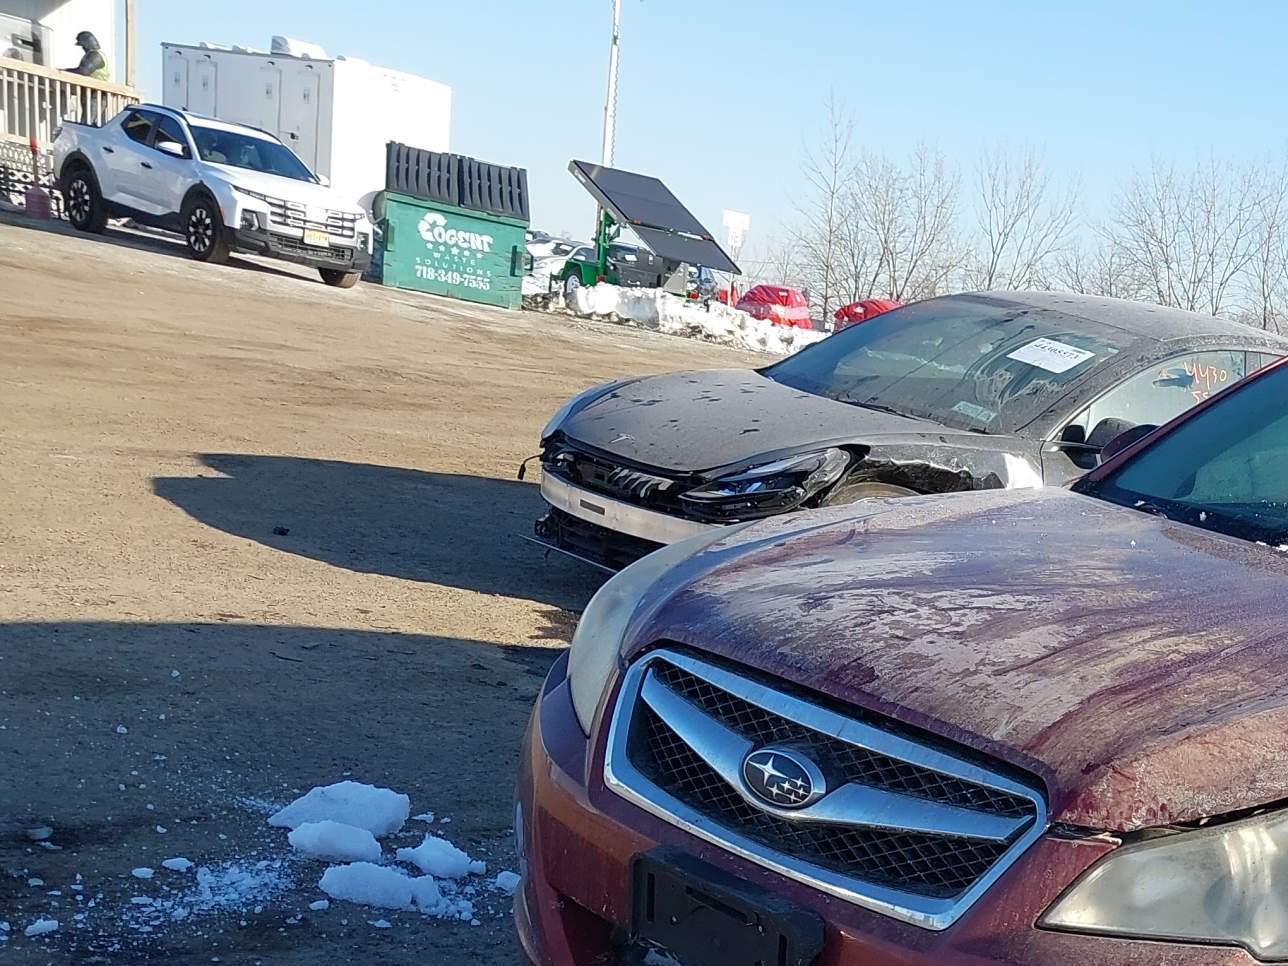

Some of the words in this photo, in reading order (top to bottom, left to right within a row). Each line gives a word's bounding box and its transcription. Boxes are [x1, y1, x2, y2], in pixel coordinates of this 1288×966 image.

[415, 256, 492, 277] SOLUTIONS
[433, 252, 476, 266] WASTE
[415, 265, 491, 291] 718-349-7555
[1184, 361, 1227, 390] 4430
